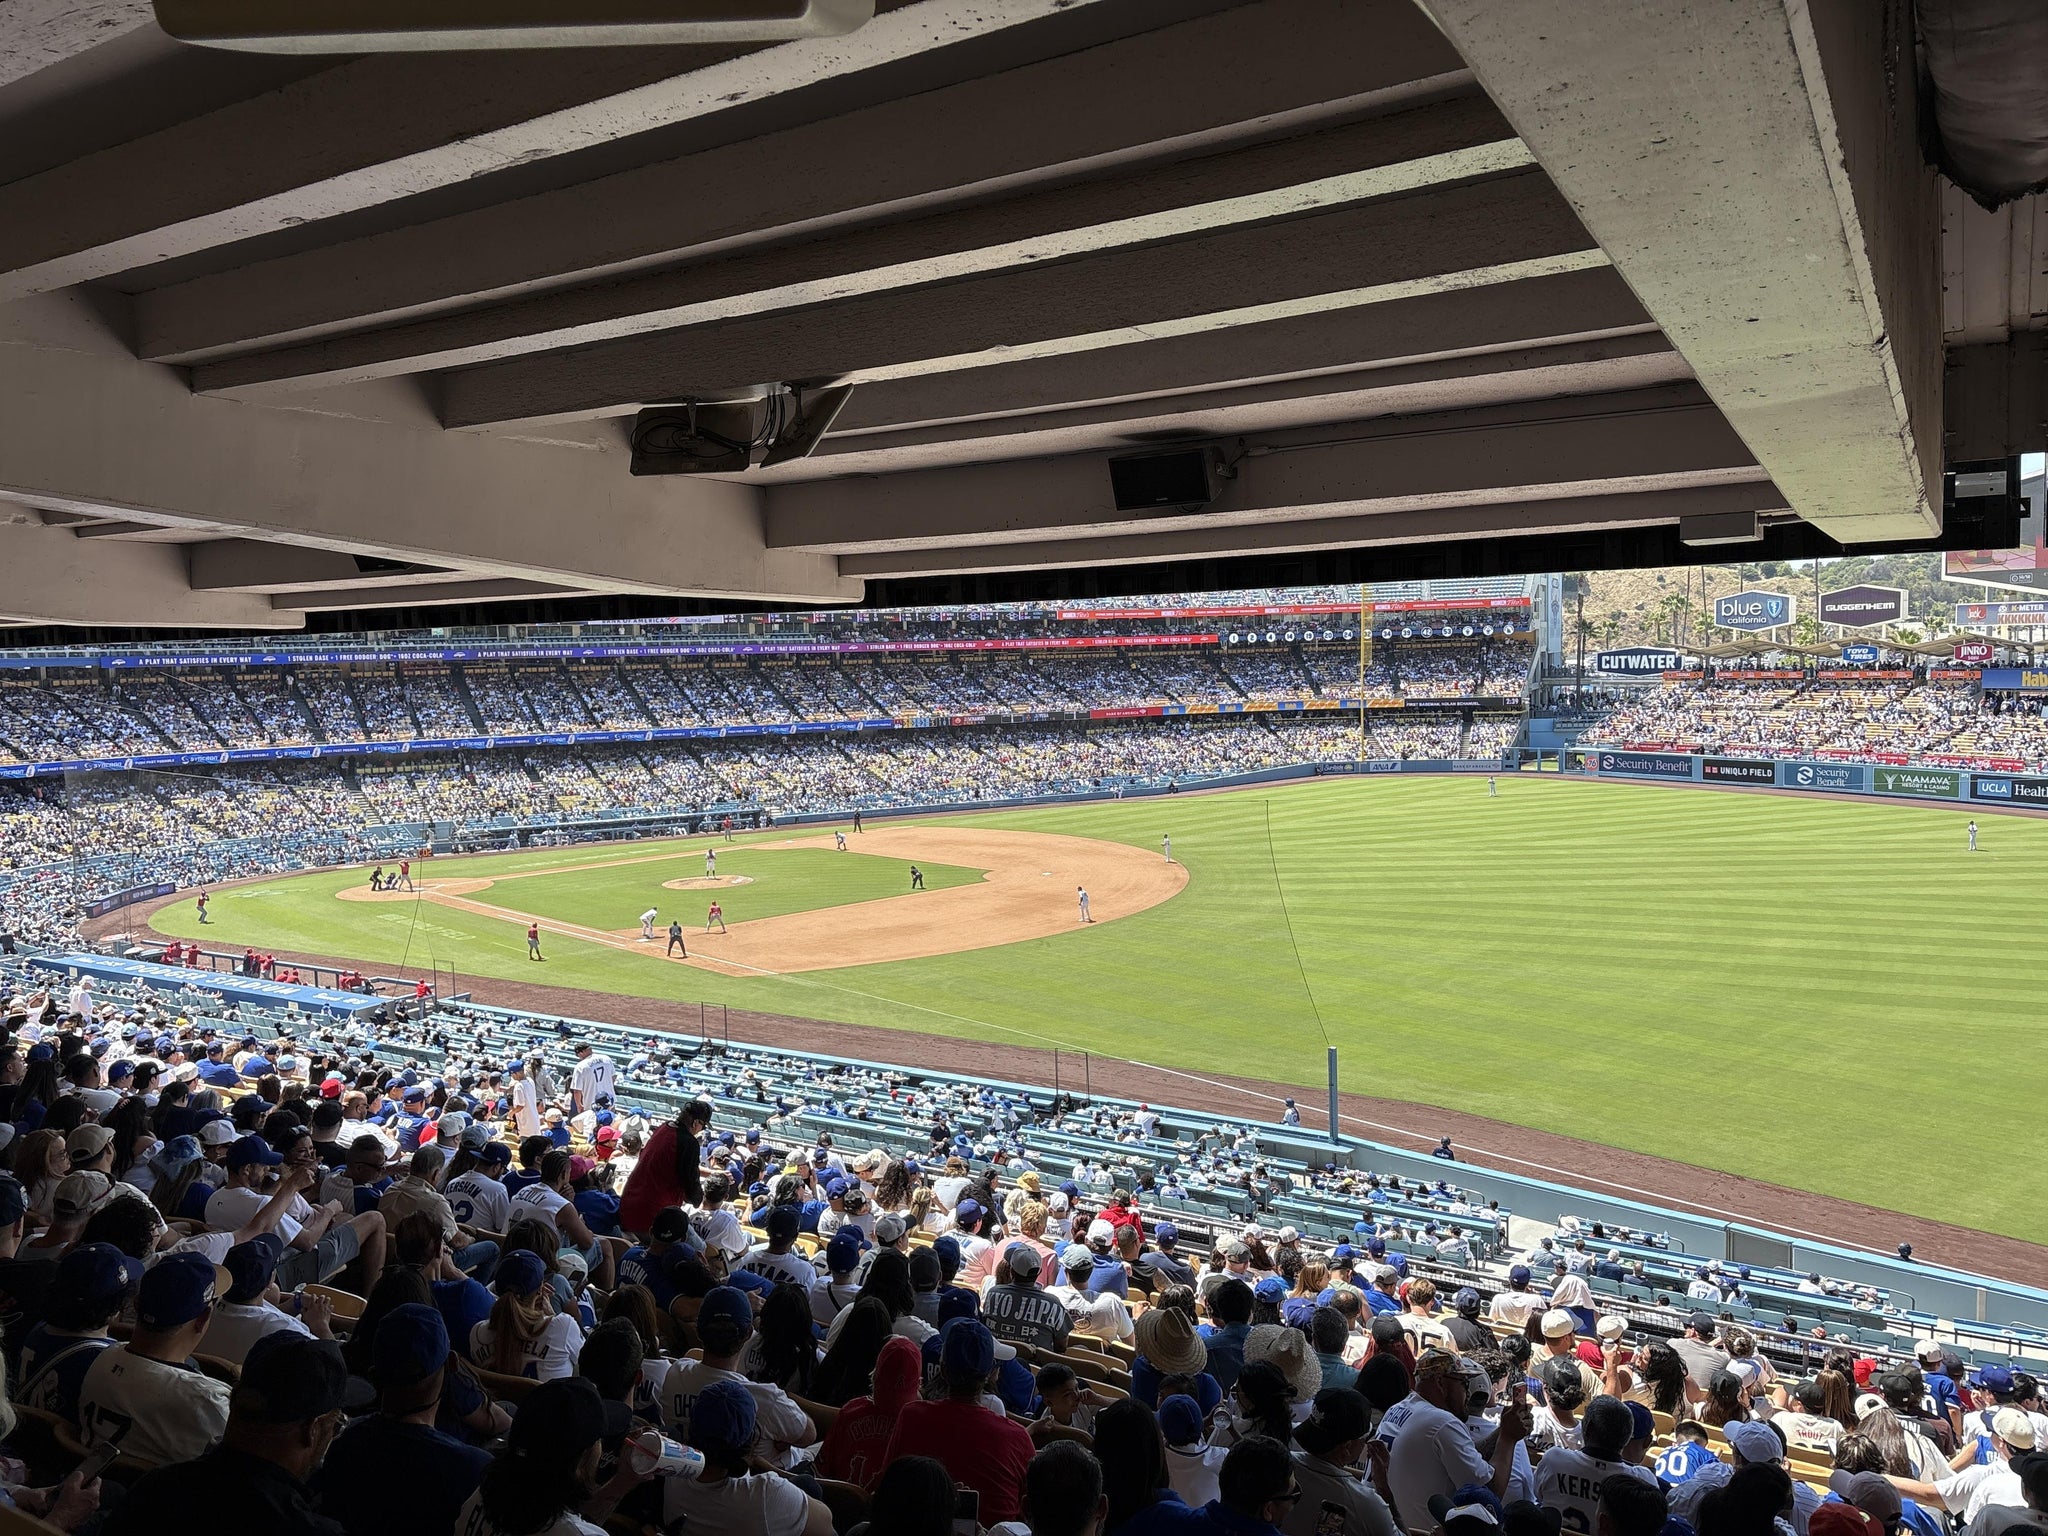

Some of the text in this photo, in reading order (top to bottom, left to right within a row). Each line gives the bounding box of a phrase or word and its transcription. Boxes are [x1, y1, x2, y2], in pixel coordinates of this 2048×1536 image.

[1721, 600, 1762, 617] blue
[1825, 602, 1895, 611] GUGGENHEIM
[2011, 604, 2044, 612] K-METER
[1727, 616, 1766, 624] california
[1960, 646, 1987, 658] JINRO
[1601, 654, 1675, 670] CUTWATER
[1372, 762, 1389, 770] ANA
[1616, 758, 1690, 772] Security Benefit
[1720, 766, 1772, 777] UNIQLO FIELD
[1816, 767, 1850, 780] Security
[1816, 776, 1846, 787] Benefit
[1981, 783, 2008, 793] UCLA
[124, 964, 301, 995] DODGER STADIUM
[593, 1066, 604, 1083] 17
[515, 1188, 548, 1206] SCULLY
[1570, 1260, 1578, 1272] 5
[619, 1259, 648, 1286] OHTANI
[1696, 1291, 1708, 1299] 17
[1014, 1296, 1065, 1332] JAPAN
[1020, 1325, 1040, 1337] 日本
[1796, 1429, 1825, 1441] TROUT
[1556, 1473, 1601, 1503] KERS
